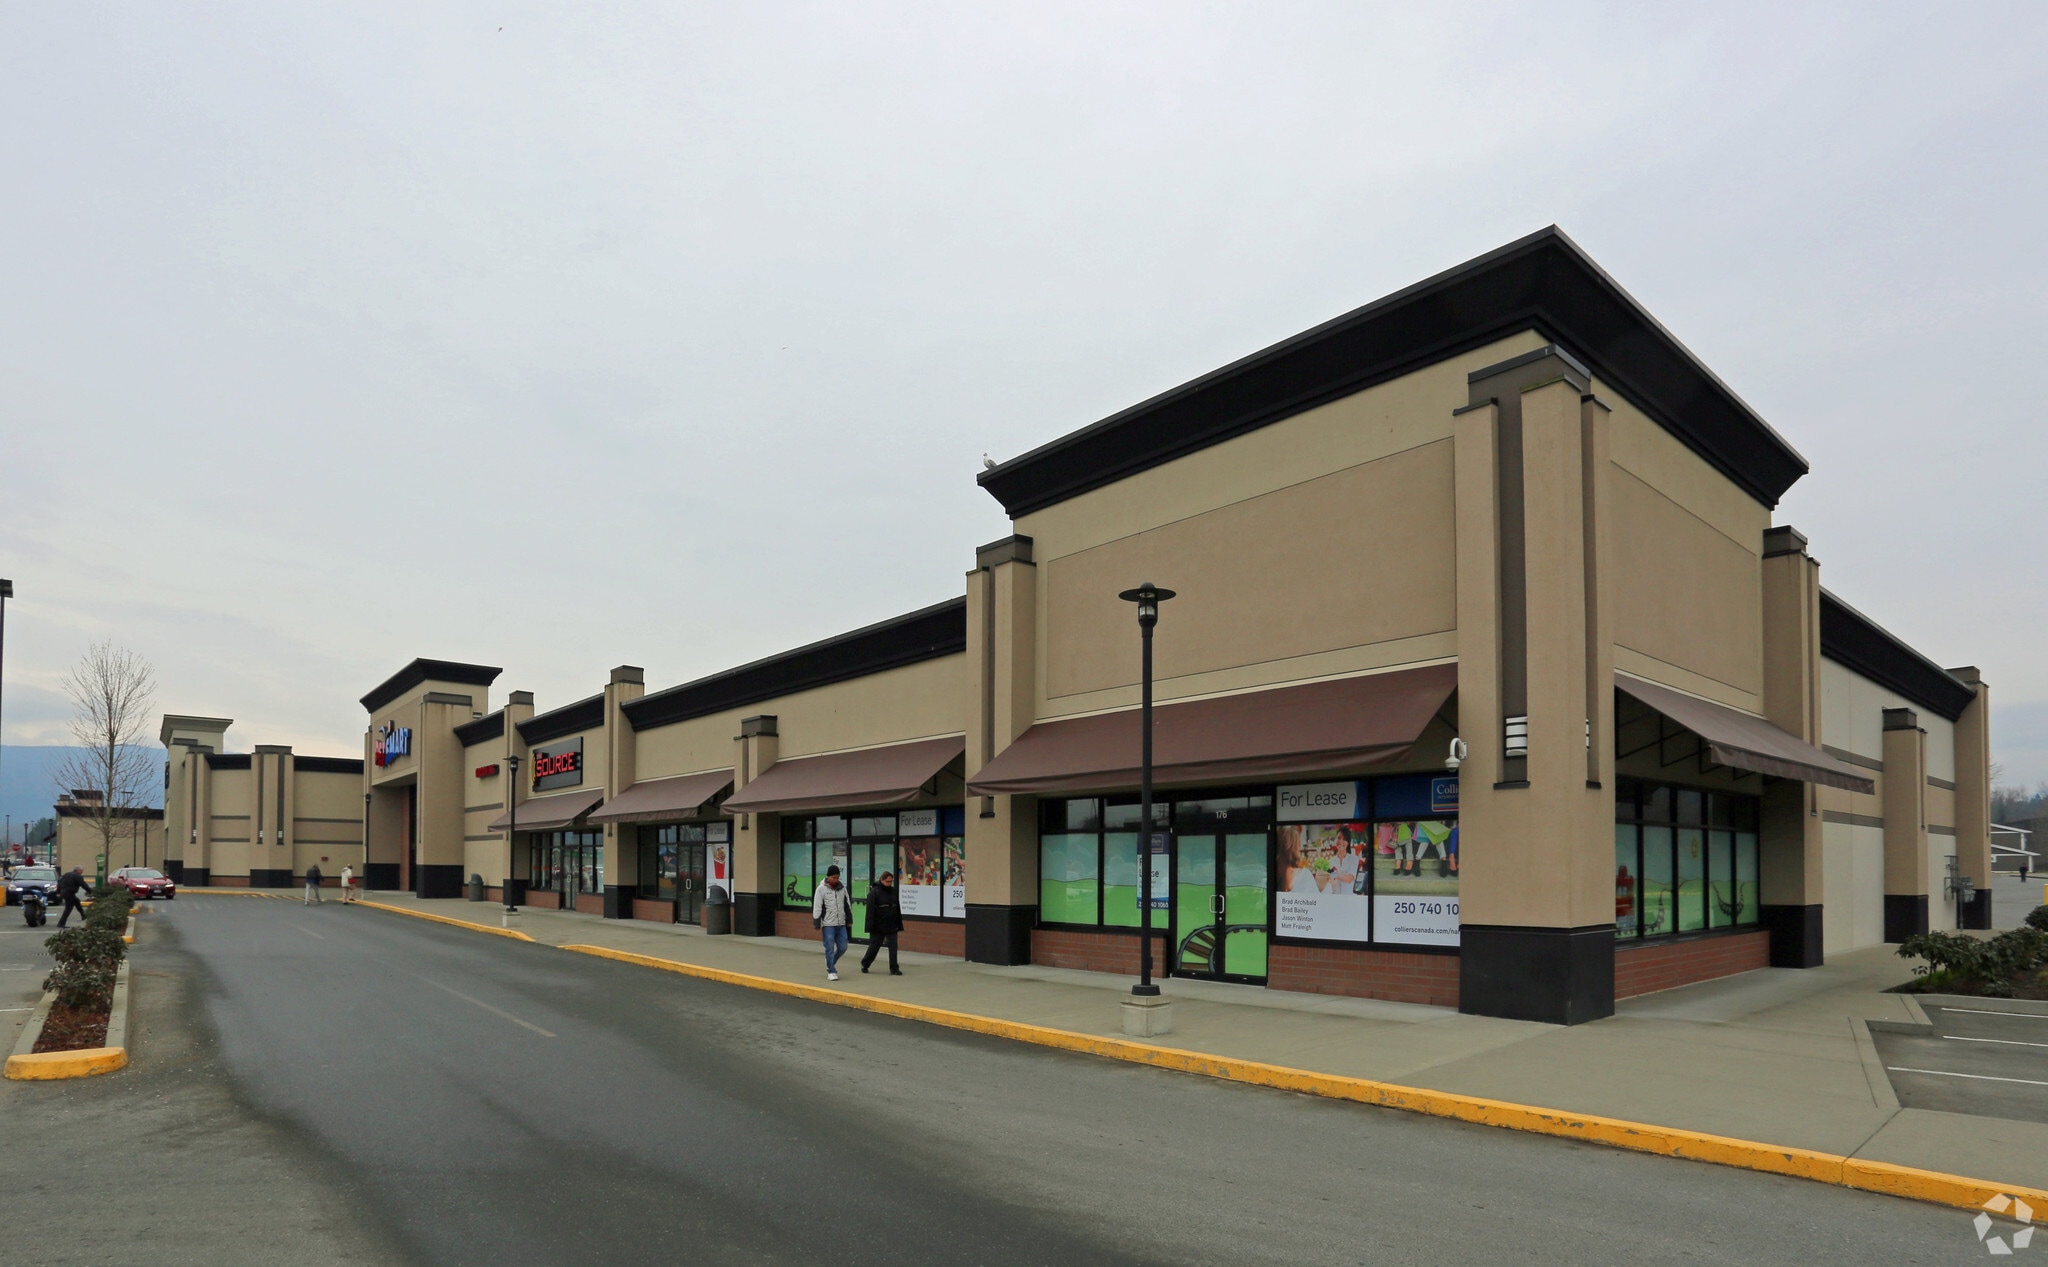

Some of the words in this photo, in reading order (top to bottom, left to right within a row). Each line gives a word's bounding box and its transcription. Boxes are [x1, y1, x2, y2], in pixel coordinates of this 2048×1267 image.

[536, 752, 575, 777] SOURCE
[1281, 791, 1303, 807] For
[1306, 790, 1347, 806] Lease
[1216, 809, 1228, 819] 176
[901, 815, 911, 826] For
[912, 815, 932, 826] Lease
[952, 889, 963, 898] 250
[1394, 902, 1416, 914] 250
[1419, 902, 1442, 915] 740
[1446, 903, 1460, 916] 10
